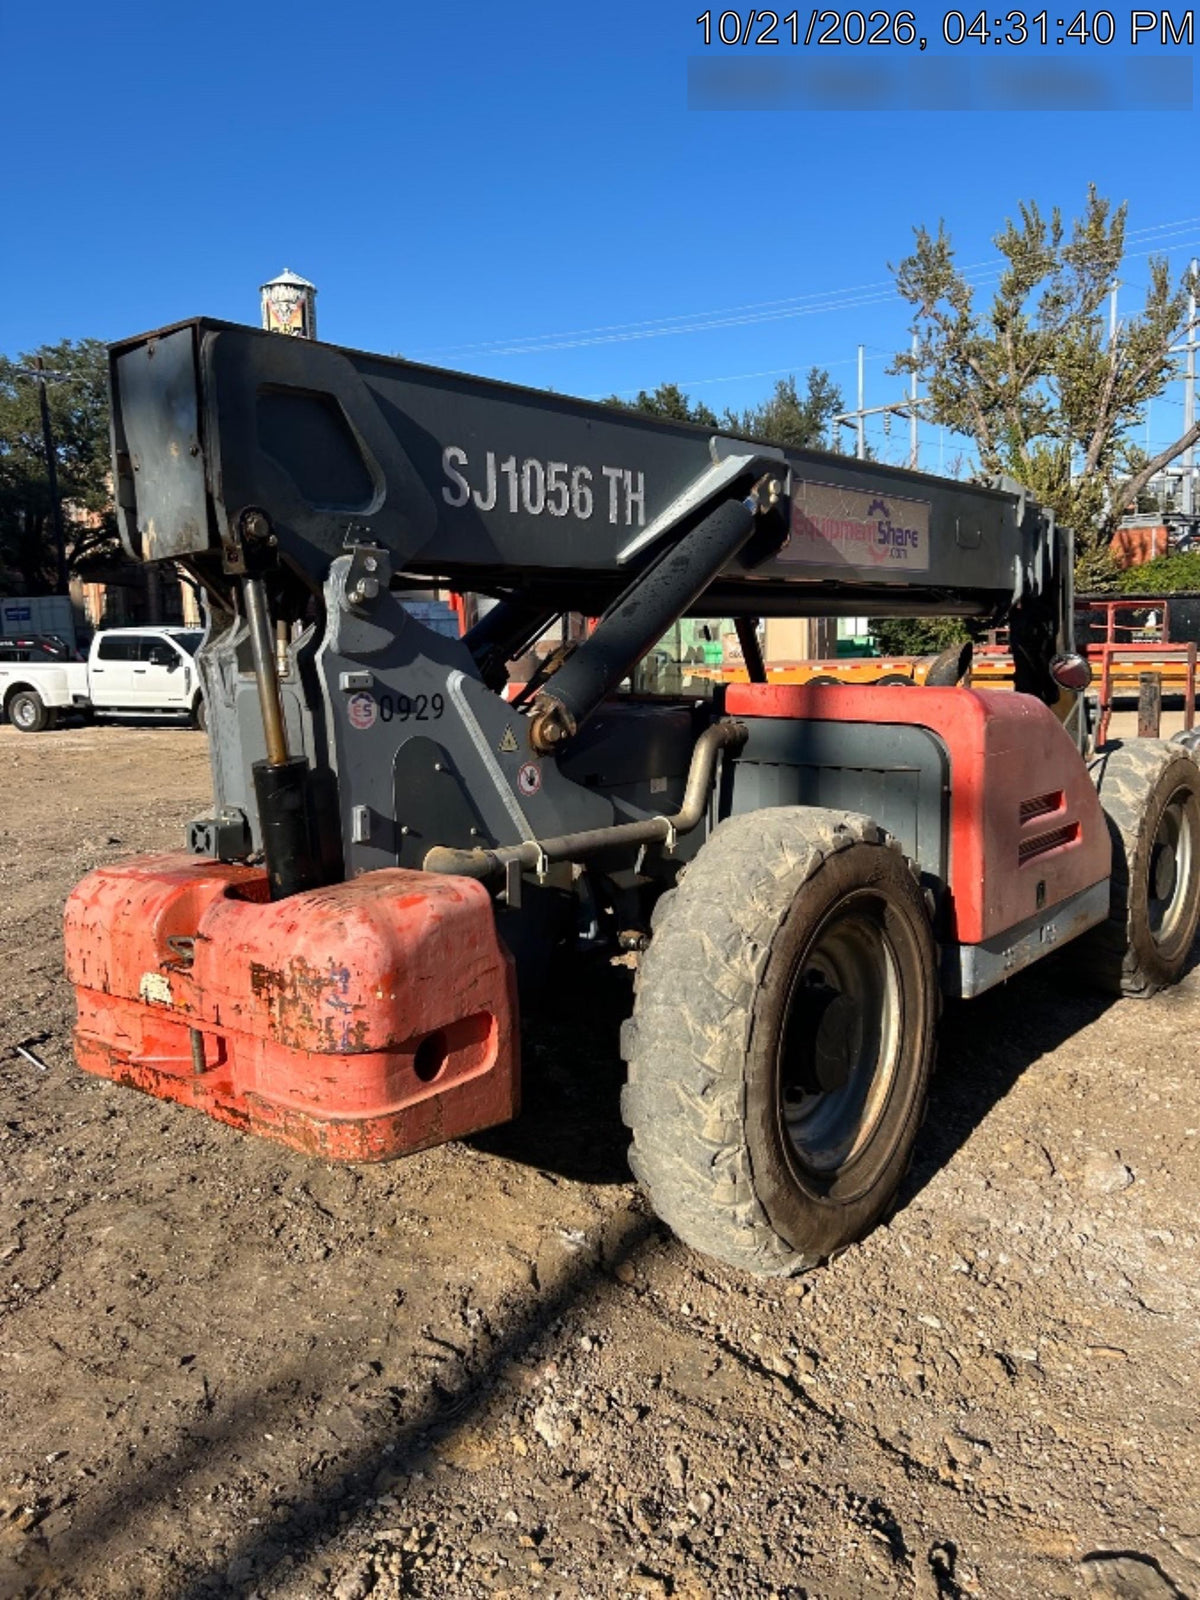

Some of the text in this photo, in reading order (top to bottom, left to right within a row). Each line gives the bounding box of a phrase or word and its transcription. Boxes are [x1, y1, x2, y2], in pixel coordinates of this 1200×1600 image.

[442, 445, 646, 527] SJ1056 TH
[380, 692, 445, 722] 0929
